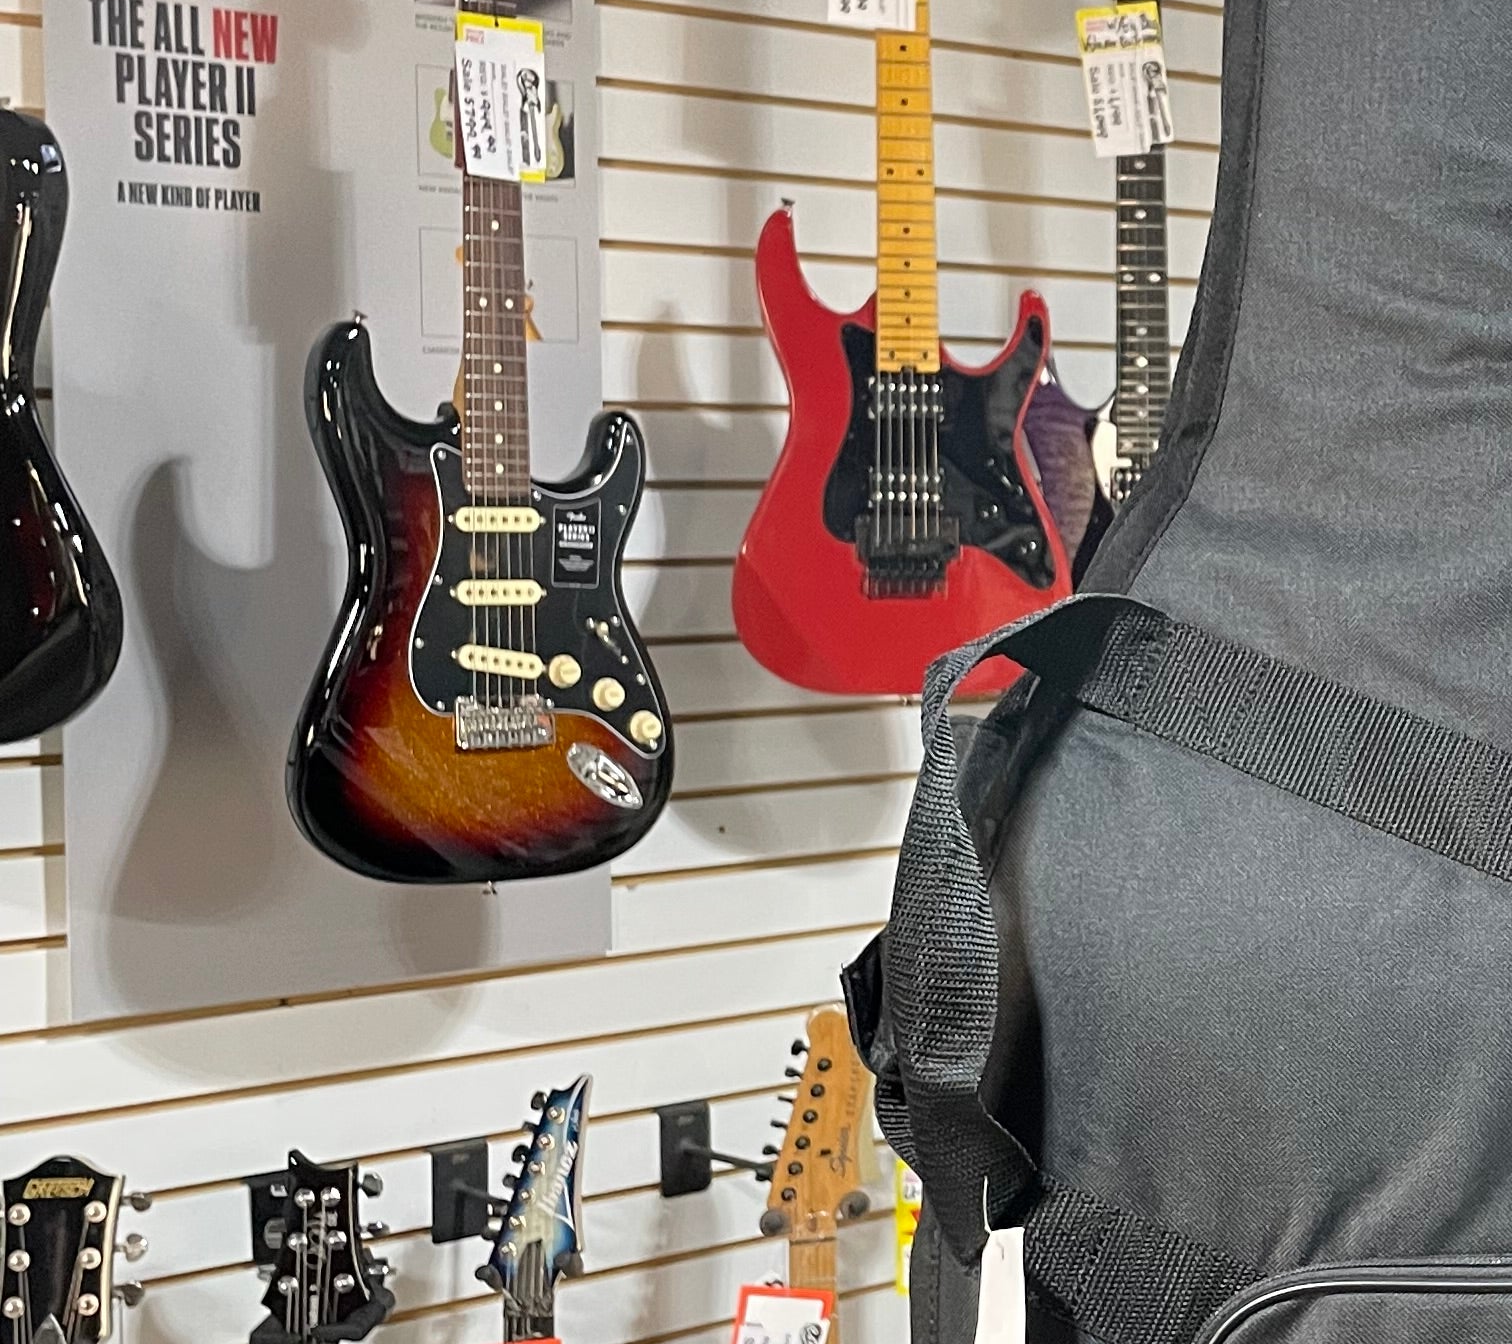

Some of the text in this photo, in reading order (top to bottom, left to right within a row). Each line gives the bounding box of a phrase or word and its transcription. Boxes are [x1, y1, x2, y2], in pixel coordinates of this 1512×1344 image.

[154, 1, 206, 56] ALL
[212, 7, 279, 64] NEW
[115, 52, 257, 117] PLAYER II
[133, 111, 242, 169] SERIES
[117, 180, 261, 213] A NEW KIND OF PLAYER
